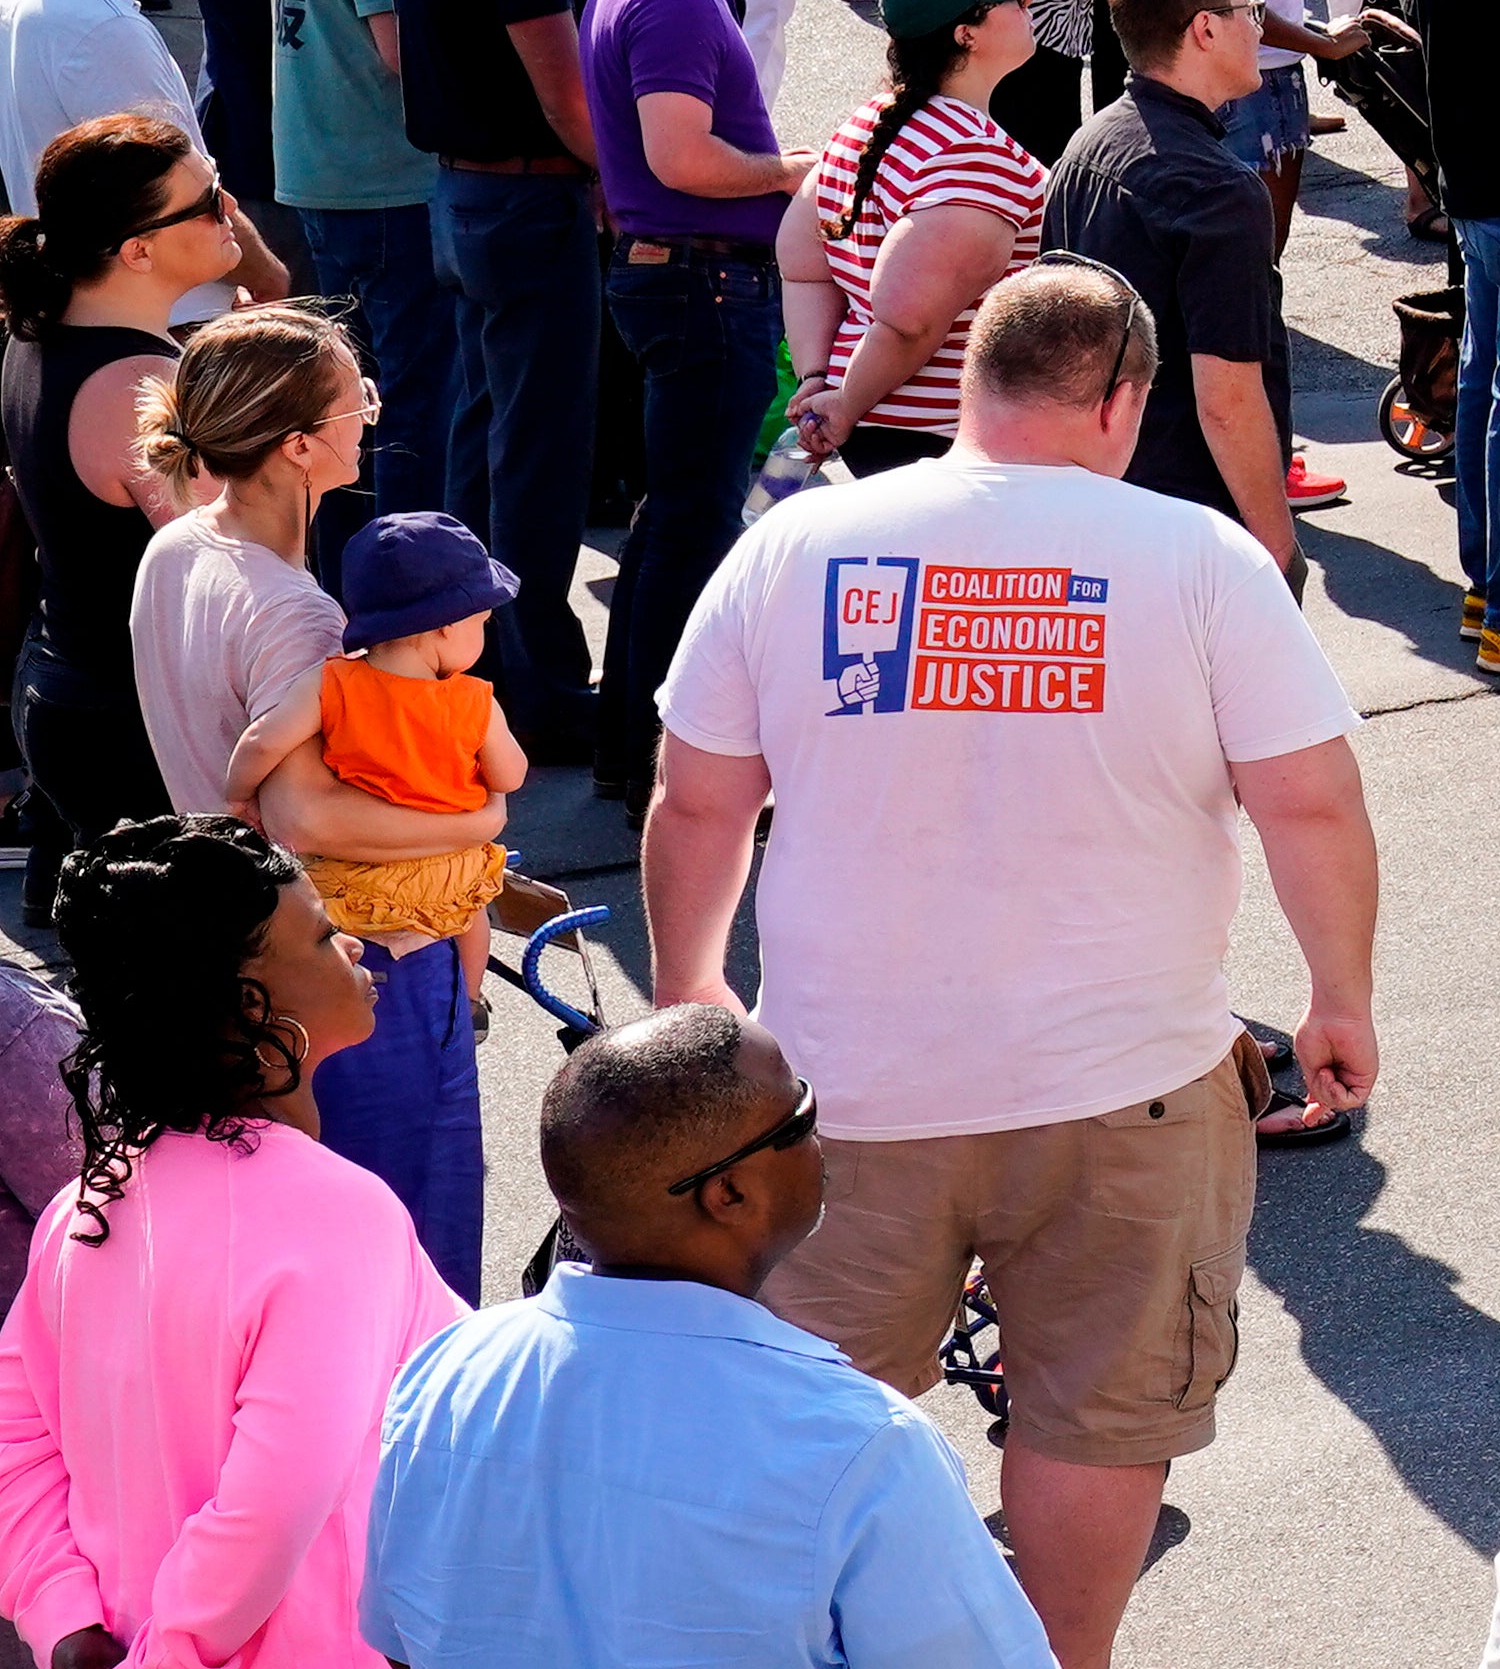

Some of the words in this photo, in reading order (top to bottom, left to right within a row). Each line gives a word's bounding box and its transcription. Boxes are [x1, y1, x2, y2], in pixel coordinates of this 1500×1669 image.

[931, 572, 1062, 600] COALITION
[1072, 580, 1101, 599] FOR
[842, 588, 898, 625] CEJ
[925, 613, 1100, 653] ECONOMIC
[917, 661, 1094, 710] JUSTICE
